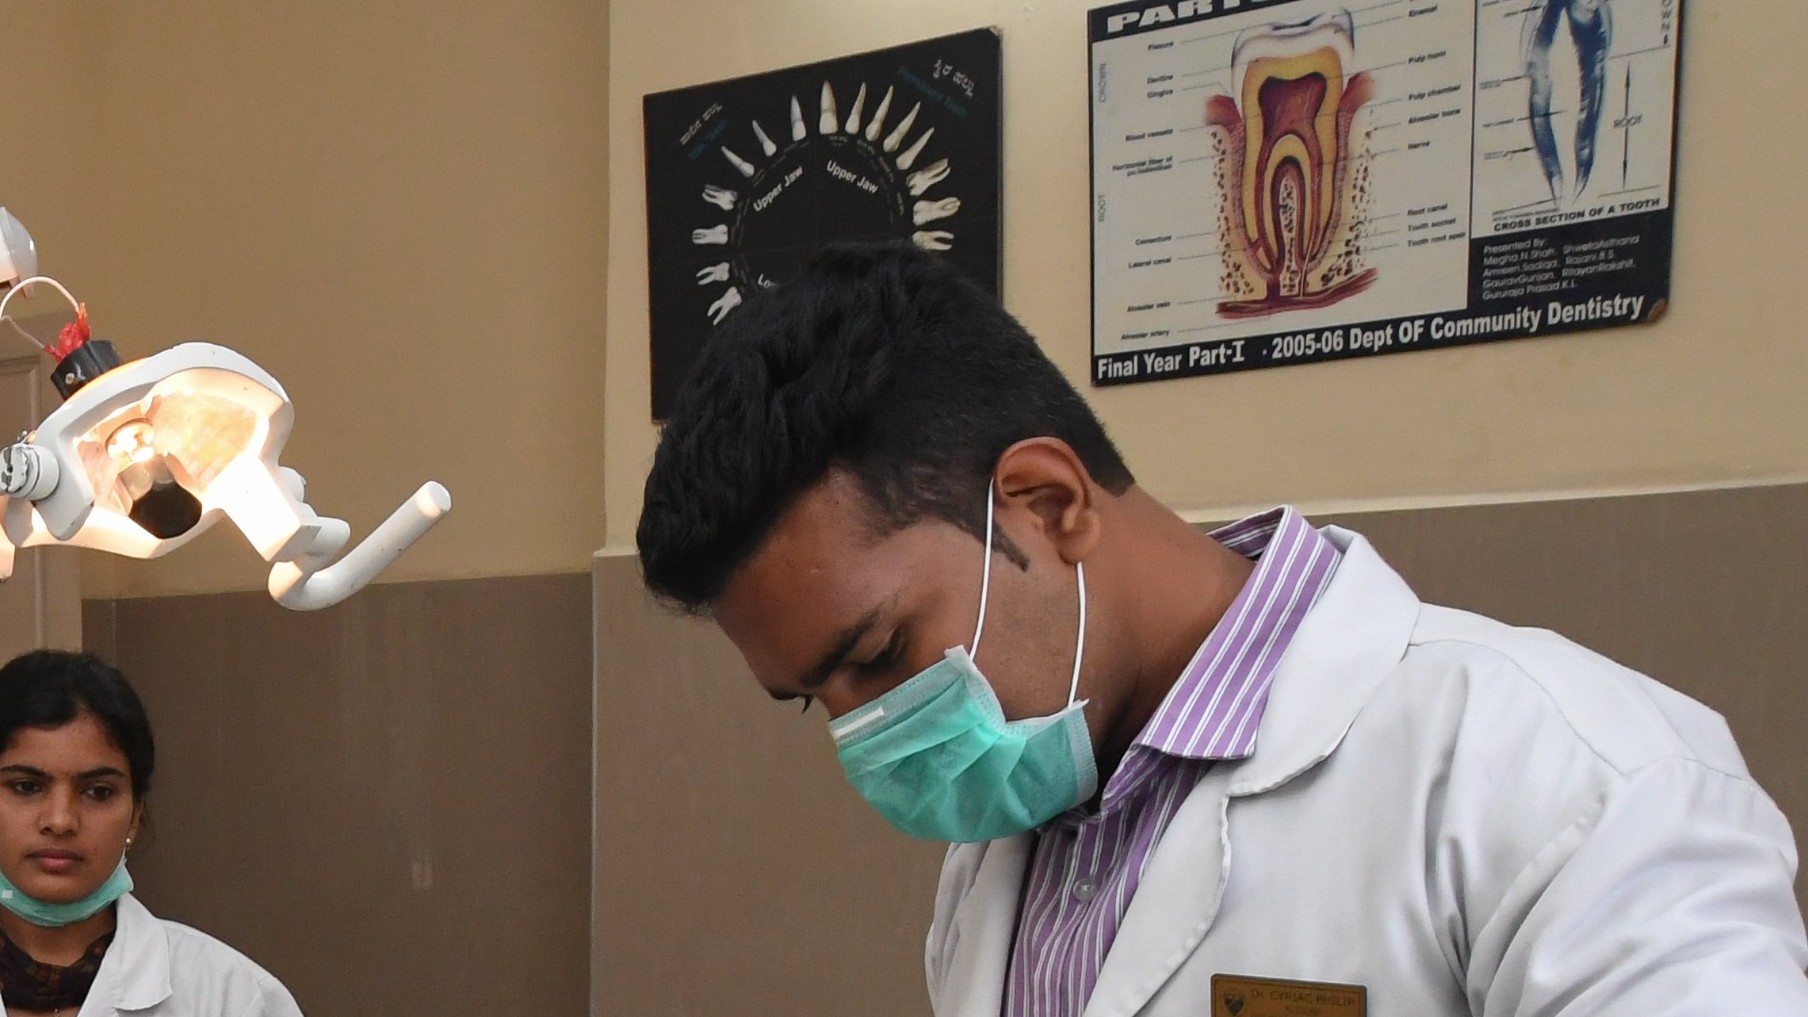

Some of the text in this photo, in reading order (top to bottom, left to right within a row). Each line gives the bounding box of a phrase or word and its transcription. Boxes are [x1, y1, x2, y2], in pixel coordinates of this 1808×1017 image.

[1107, 0, 1275, 33] PAR
[753, 183, 783, 212] Upper
[784, 165, 803, 188] Jaw
[826, 160, 858, 183] Upper
[857, 176, 879, 194] Jaw
[1493, 219, 1532, 232] CROSS
[1535, 212, 1585, 226] SECTION
[1589, 207, 1605, 218] OF
[1607, 205, 1616, 214] A
[1620, 198, 1660, 212] TOOTH
[1097, 293, 1645, 380] Final Year Part-I 2005-06 Dept OF Community Dentistry
